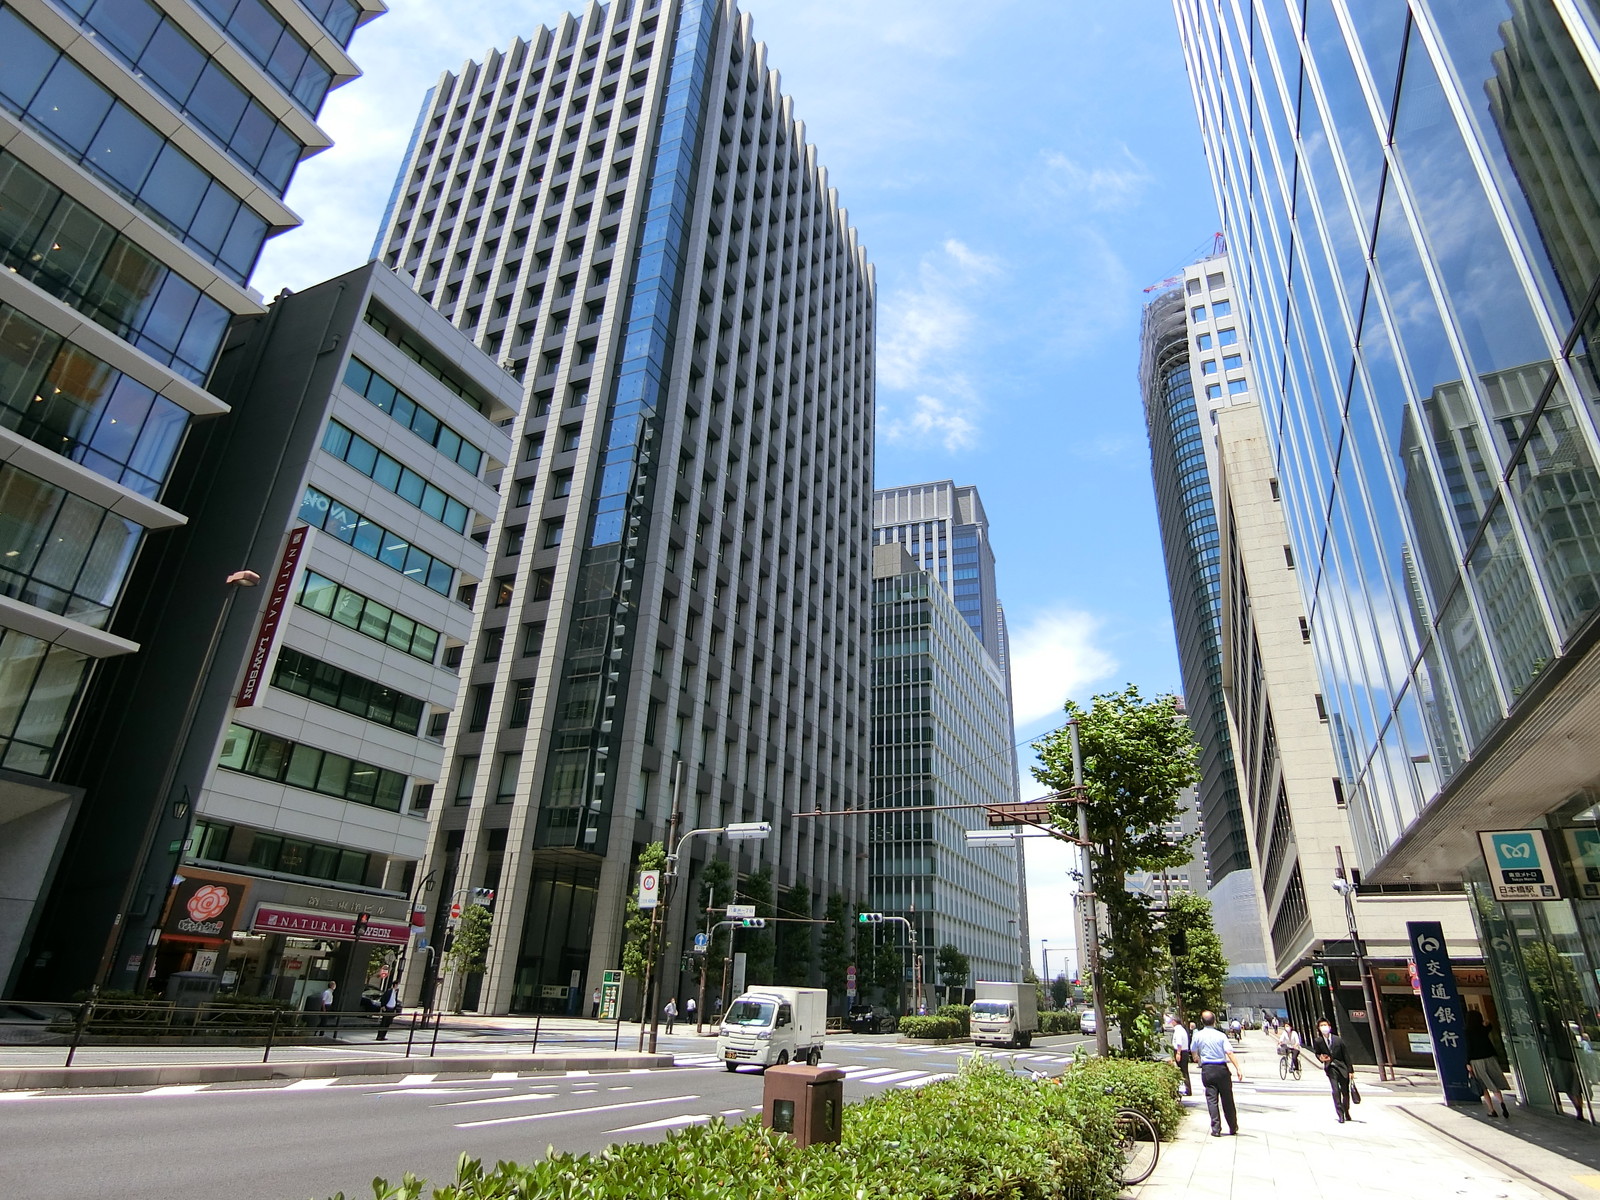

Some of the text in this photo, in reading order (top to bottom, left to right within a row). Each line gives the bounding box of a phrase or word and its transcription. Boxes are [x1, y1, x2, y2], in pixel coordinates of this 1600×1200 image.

[303, 489, 347, 524] NOVA
[242, 548, 298, 699] NATURAL LAWSON
[1499, 885, 1535, 893] 日本橋駅
[280, 917, 346, 934] NATURAL
[1426, 960, 1459, 1048] 交通銀行
